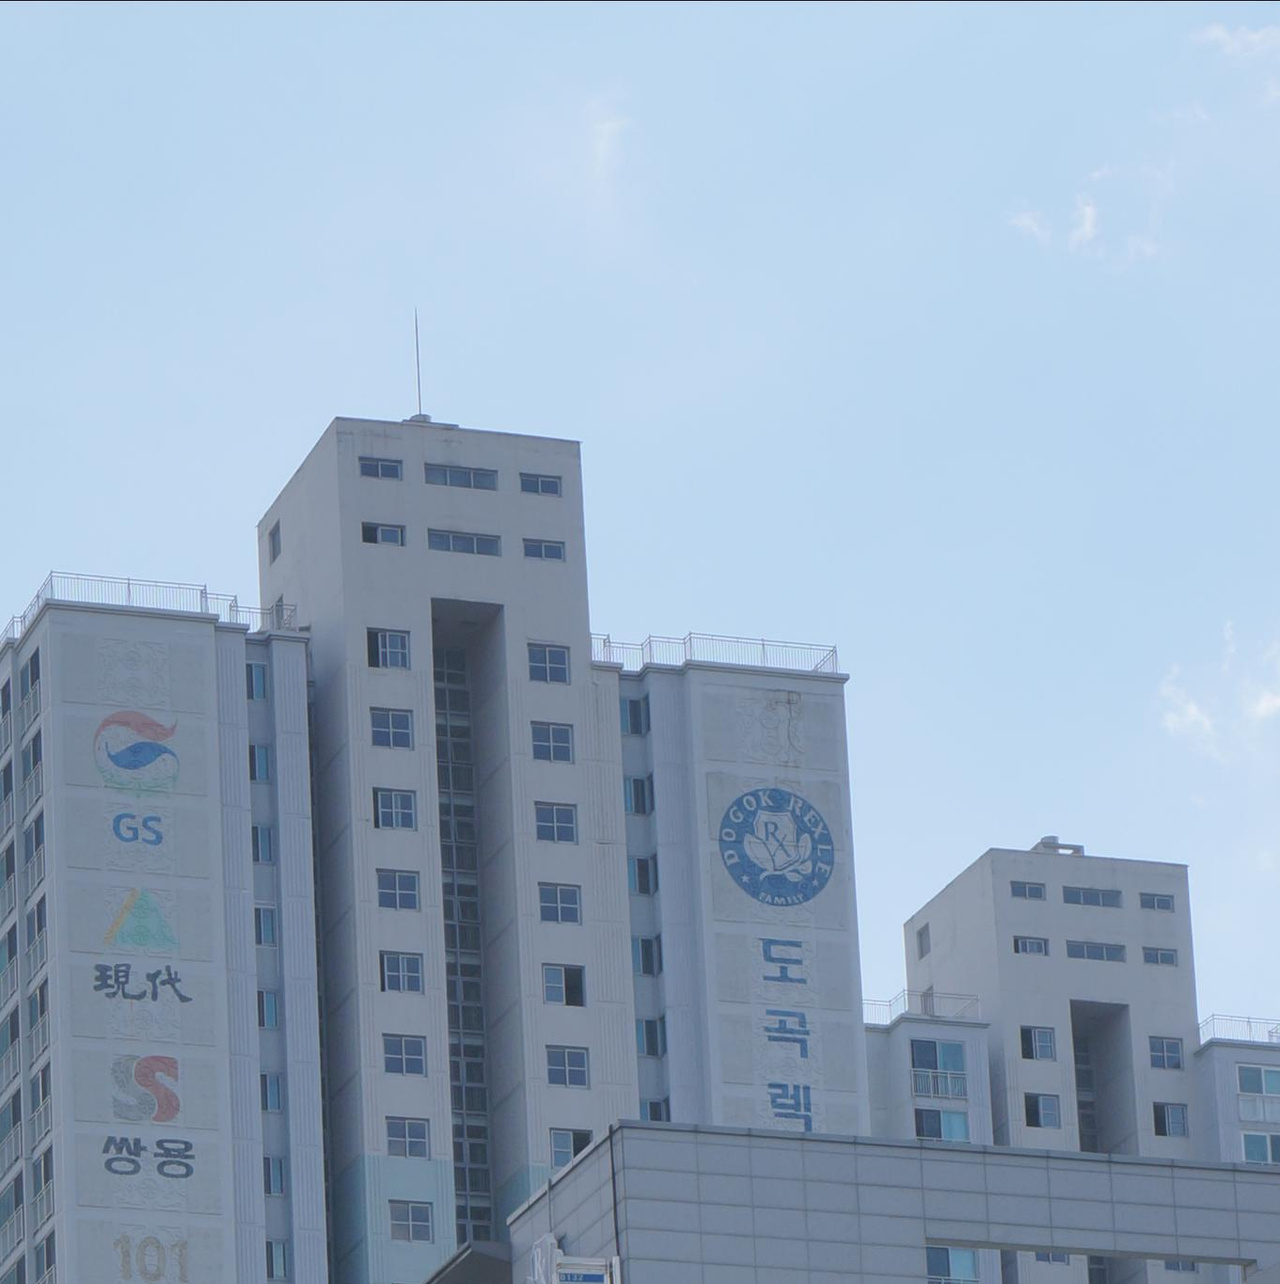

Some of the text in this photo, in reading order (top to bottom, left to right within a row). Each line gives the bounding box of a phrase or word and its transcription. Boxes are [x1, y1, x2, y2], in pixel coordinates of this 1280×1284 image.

[110, 814, 164, 847] GS
[93, 963, 192, 1003] 現代
[101, 1137, 196, 1179] 쌍용
[112, 1234, 189, 1284] 101
